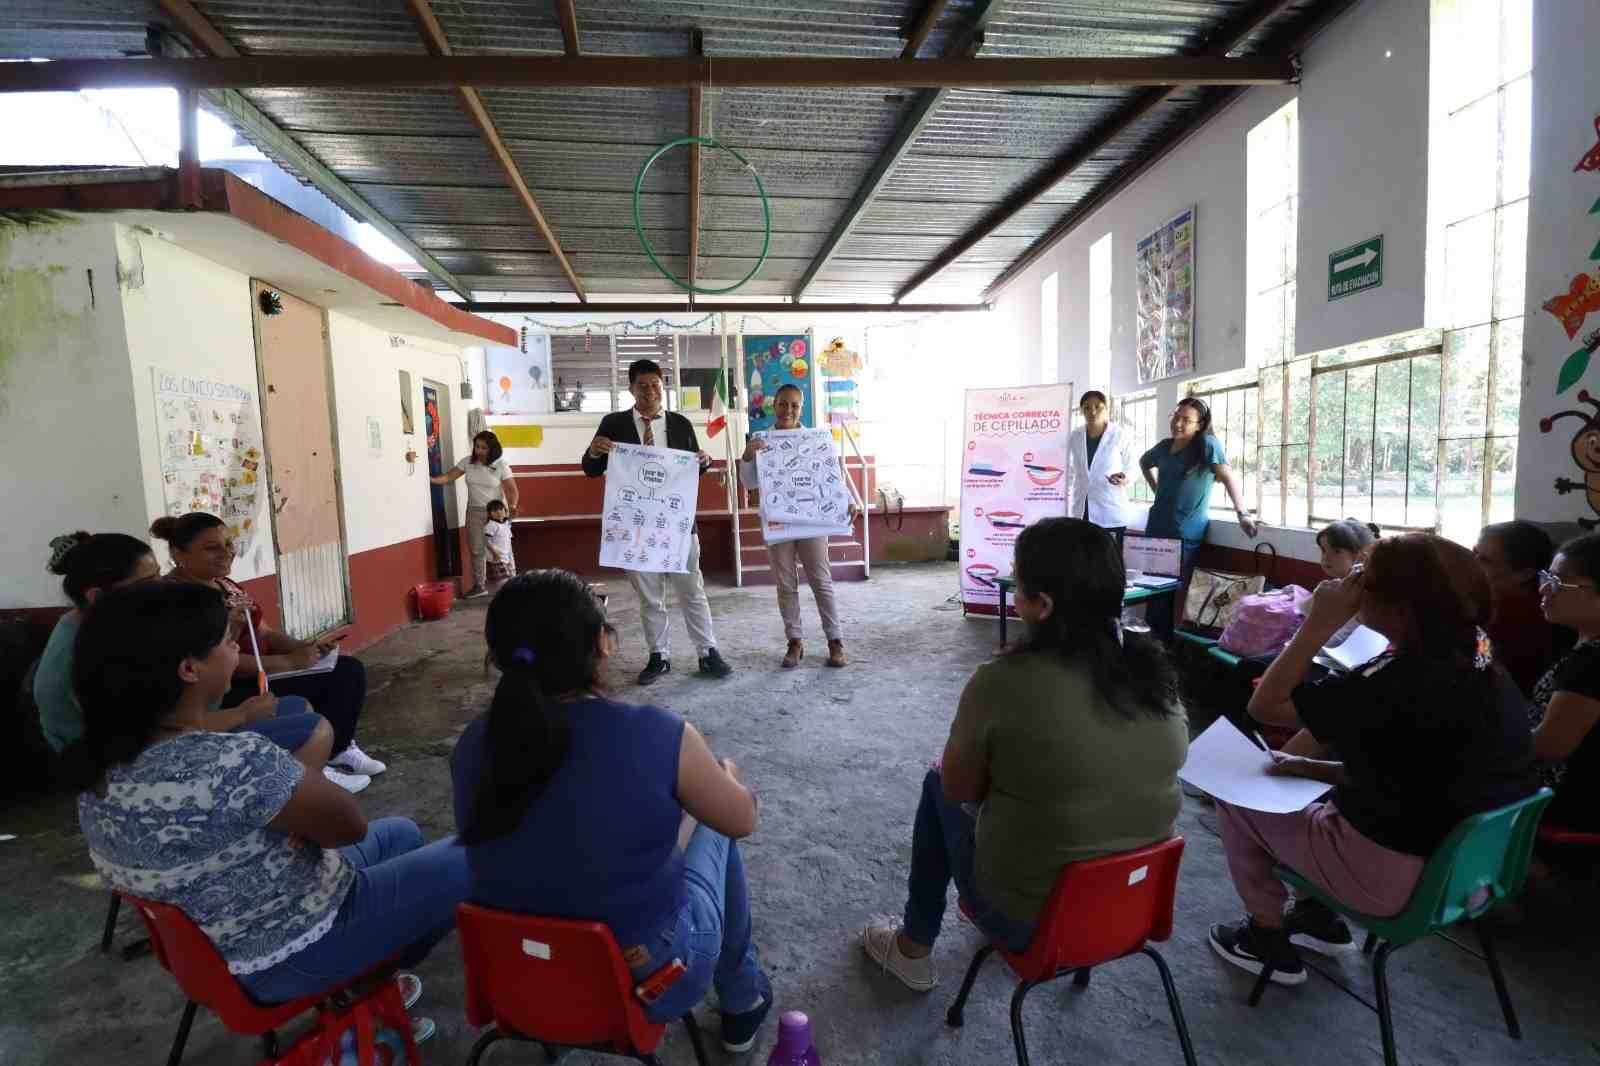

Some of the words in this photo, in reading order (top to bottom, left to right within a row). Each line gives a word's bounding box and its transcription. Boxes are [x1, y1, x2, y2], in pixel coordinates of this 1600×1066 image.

[1012, 410, 1060, 419] CORRECTA
[974, 421, 988, 432] DE
[991, 419, 1061, 431] CEPILLADO
